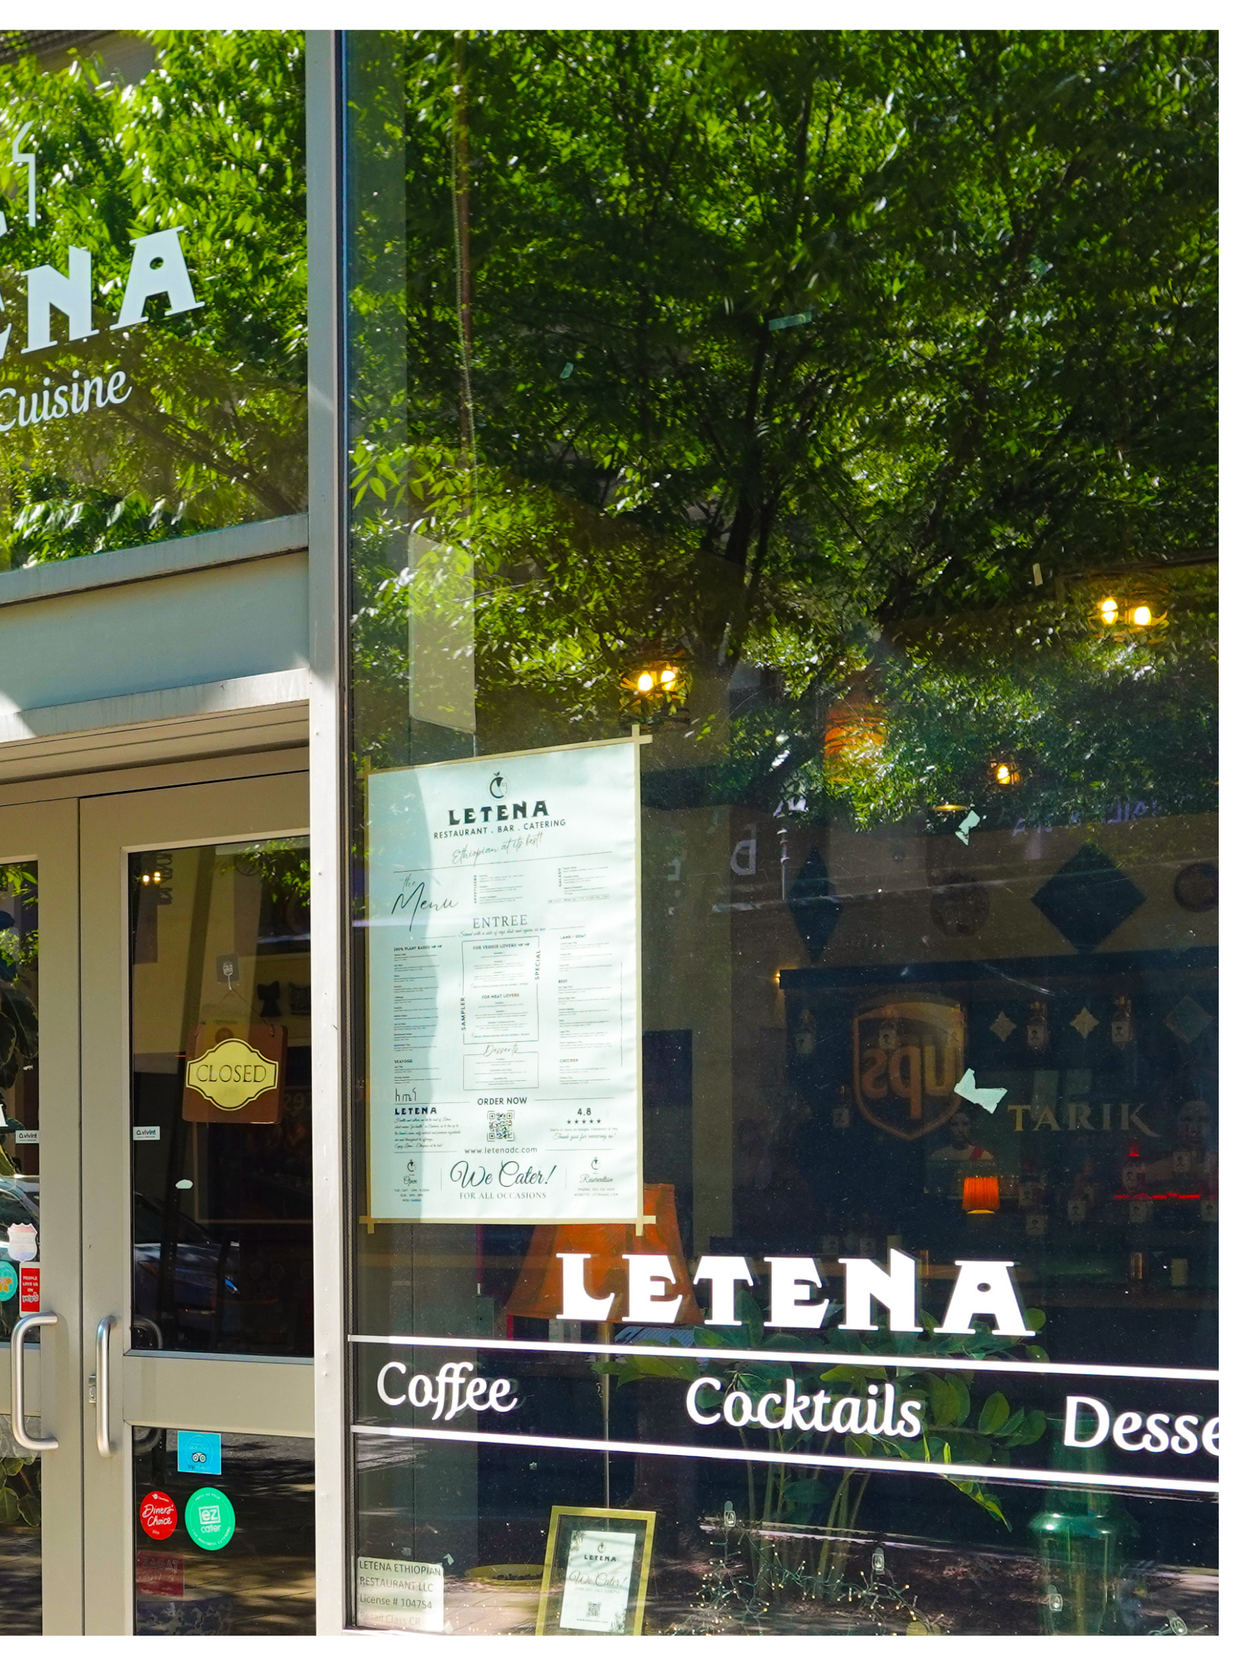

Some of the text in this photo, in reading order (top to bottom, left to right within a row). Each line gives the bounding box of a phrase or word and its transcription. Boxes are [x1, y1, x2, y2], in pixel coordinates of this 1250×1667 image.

[448, 800, 550, 826] LETENA
[433, 827, 488, 839] RESTAURANT
[497, 825, 514, 833] BAR
[523, 819, 566, 830] CATERING
[391, 882, 459, 932] Menu
[472, 914, 528, 929] ENTREE
[196, 1064, 266, 1083] CLOSED
[507, 1097, 527, 1105] NOW
[394, 1107, 437, 1115] LETENA
[577, 1107, 591, 1116] 4.8
[1007, 1103, 1162, 1137] TARIK
[464, 1146, 537, 1154] www.letenadc.com
[450, 1160, 557, 1188] We Cater!
[556, 1248, 1037, 1337] LETENA
[377, 1361, 518, 1421] Coffee
[686, 1377, 923, 1438] Cocktails
[147, 1516, 172, 1527] Choice
[201, 1508, 219, 1521] ez
[200, 1524, 221, 1534] cater
[584, 1554, 617, 1562] LETENA
[359, 1560, 441, 1576] LETENA ETHIOPIAN
[359, 1576, 434, 1592] RESTAURANT LLC
[359, 1594, 390, 1605] License
[401, 1598, 432, 1609] 104754
[386, 1614, 407, 1625] Class
